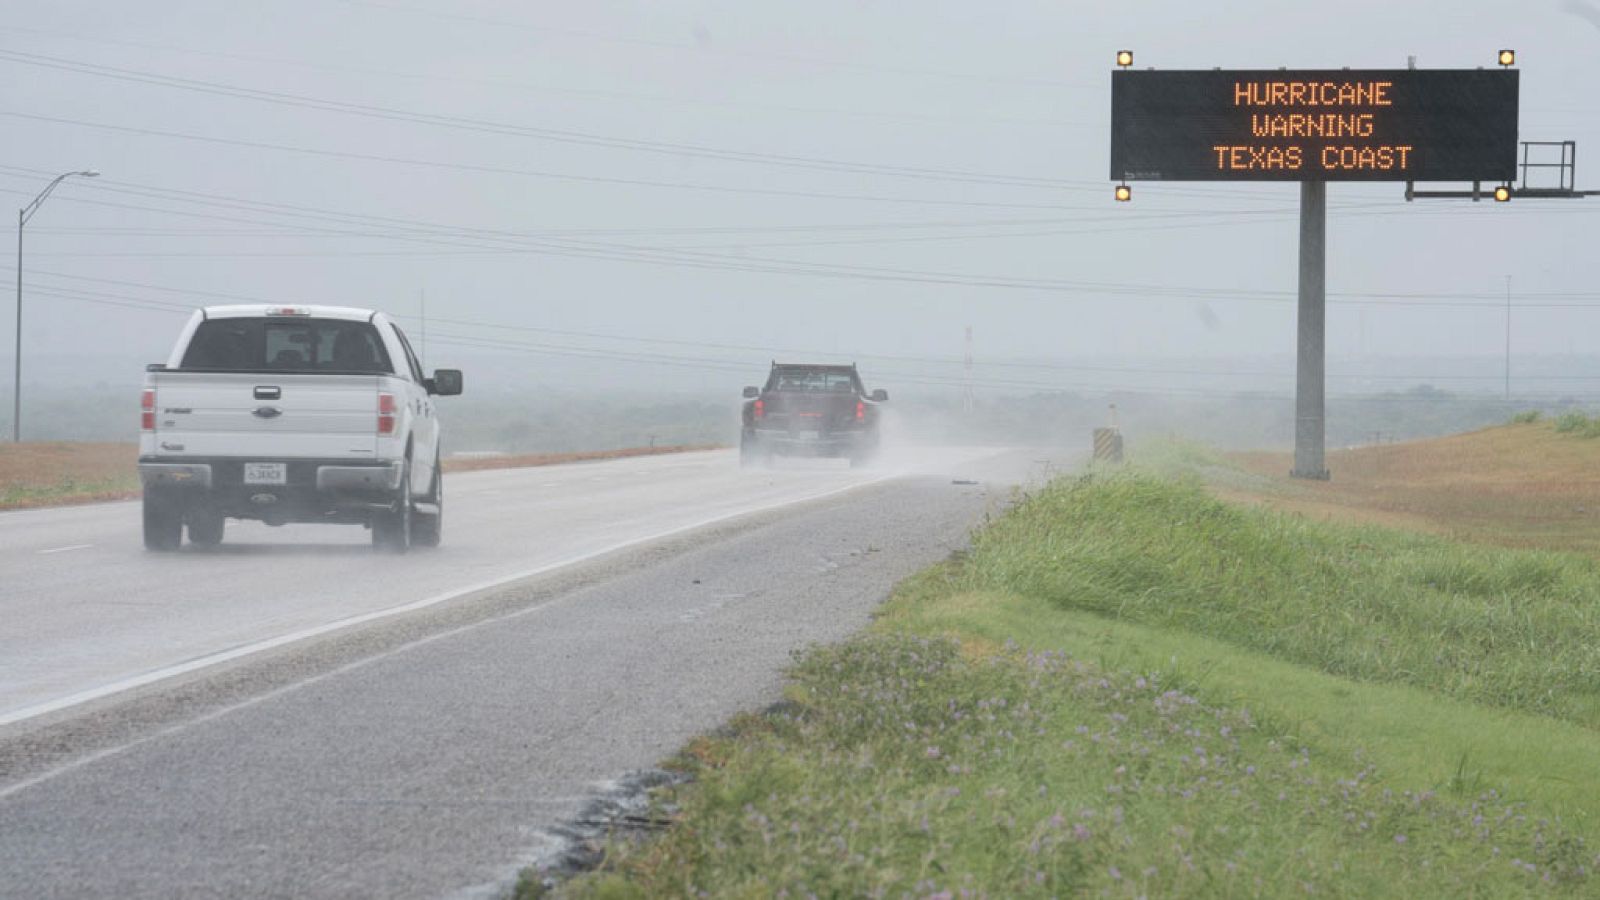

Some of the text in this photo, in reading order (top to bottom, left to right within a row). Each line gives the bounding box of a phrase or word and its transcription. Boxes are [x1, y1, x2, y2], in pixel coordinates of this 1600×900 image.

[1235, 82, 1392, 106] HURRICANE
[1252, 113, 1373, 137] WARNING
[1214, 145, 1412, 169] TEXAS COAST
